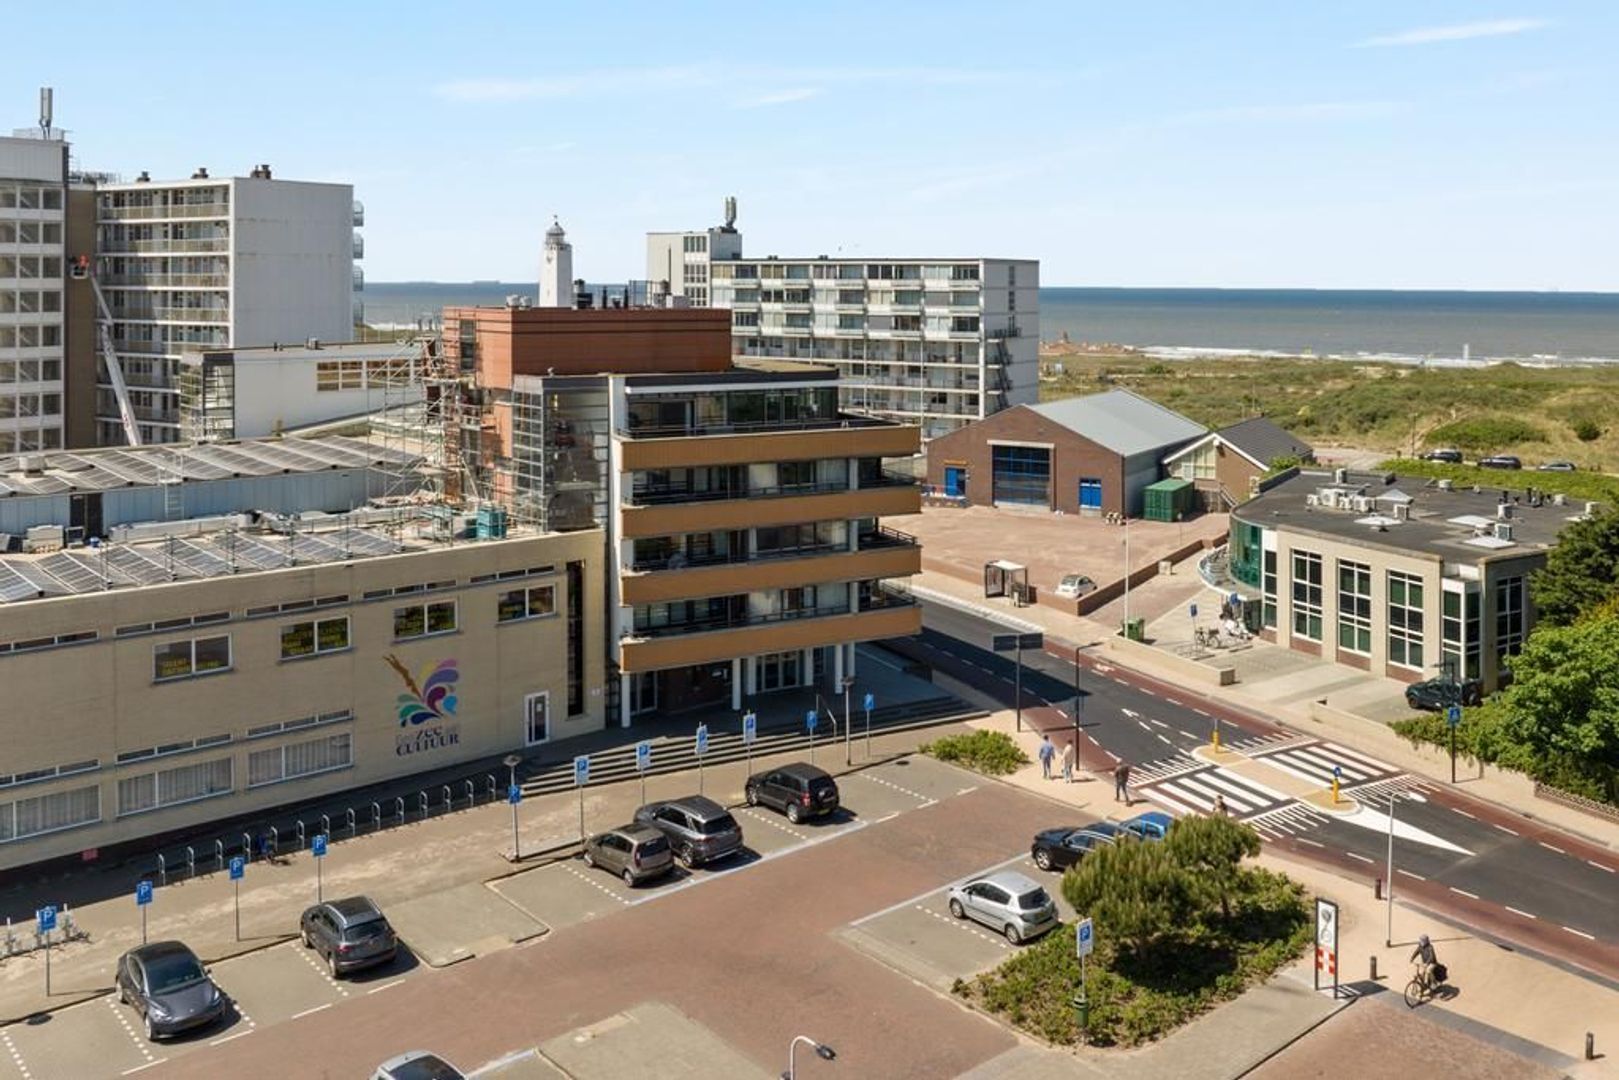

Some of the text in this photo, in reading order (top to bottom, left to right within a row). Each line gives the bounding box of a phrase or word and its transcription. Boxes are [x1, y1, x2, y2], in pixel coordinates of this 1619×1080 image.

[316, 838, 324, 849] P
[234, 860, 242, 871] P
[140, 884, 149, 896] P
[43, 910, 52, 922] P
